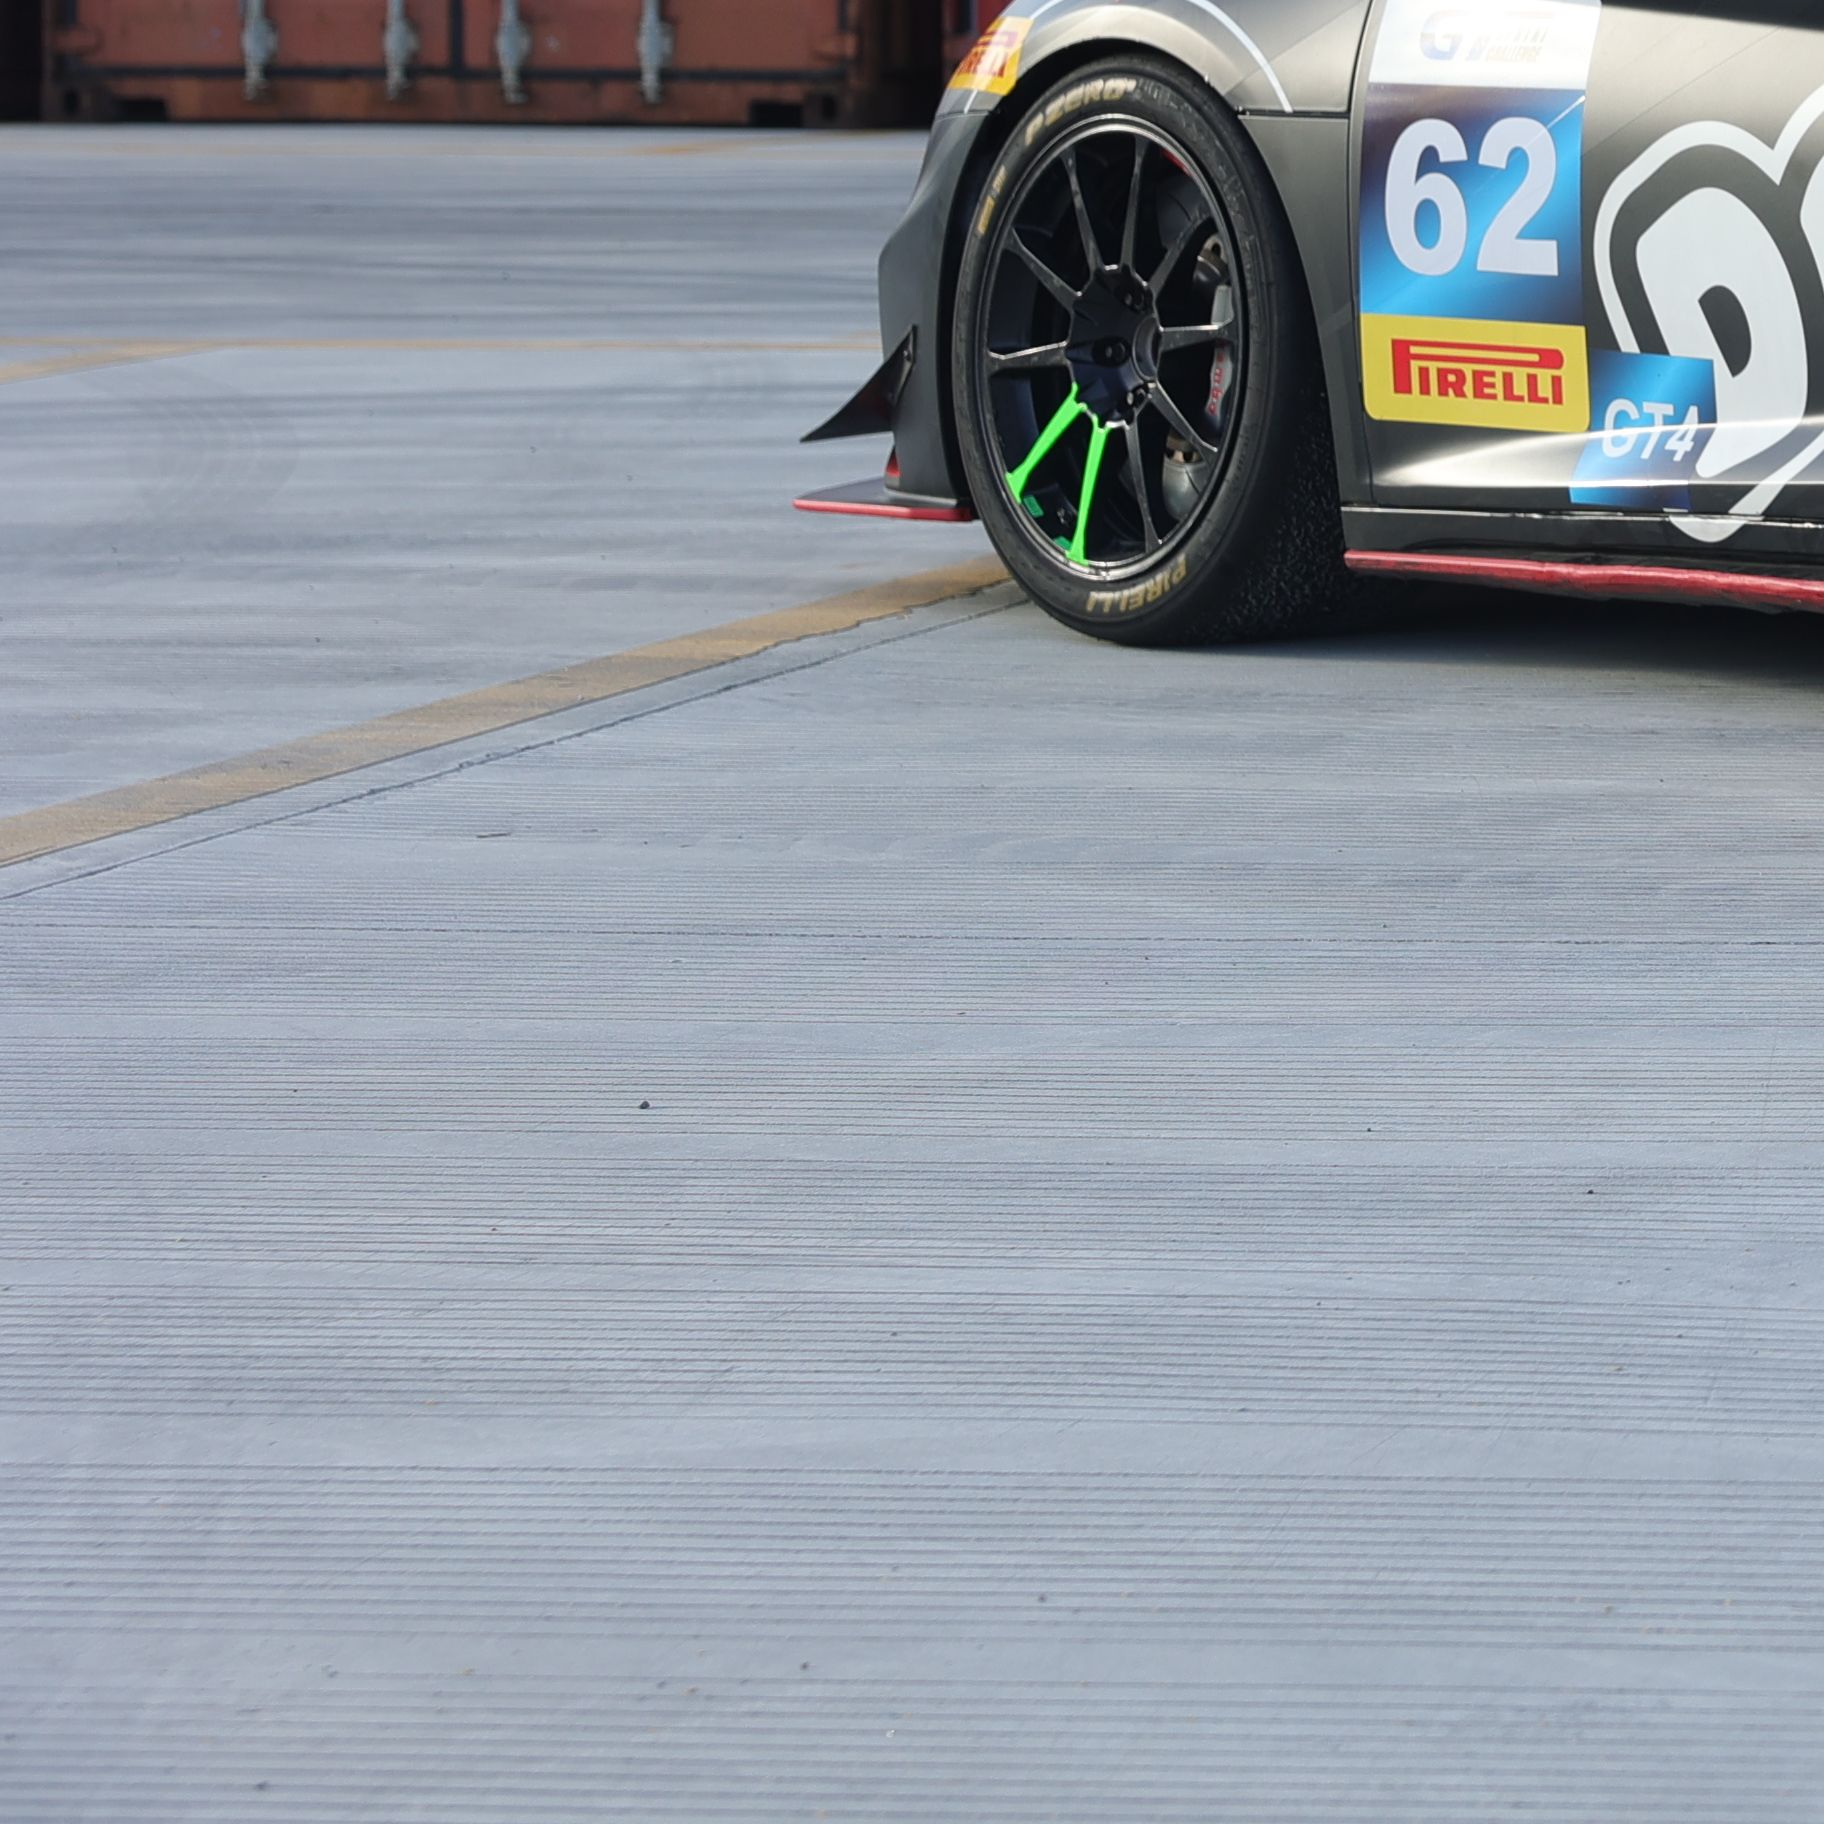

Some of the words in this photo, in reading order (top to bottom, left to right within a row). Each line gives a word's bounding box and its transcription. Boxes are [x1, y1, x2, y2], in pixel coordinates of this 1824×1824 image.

[1385, 117, 1559, 278] 62
[1391, 337, 1565, 406] PIRELLI
[1603, 397, 1701, 462] GT4
